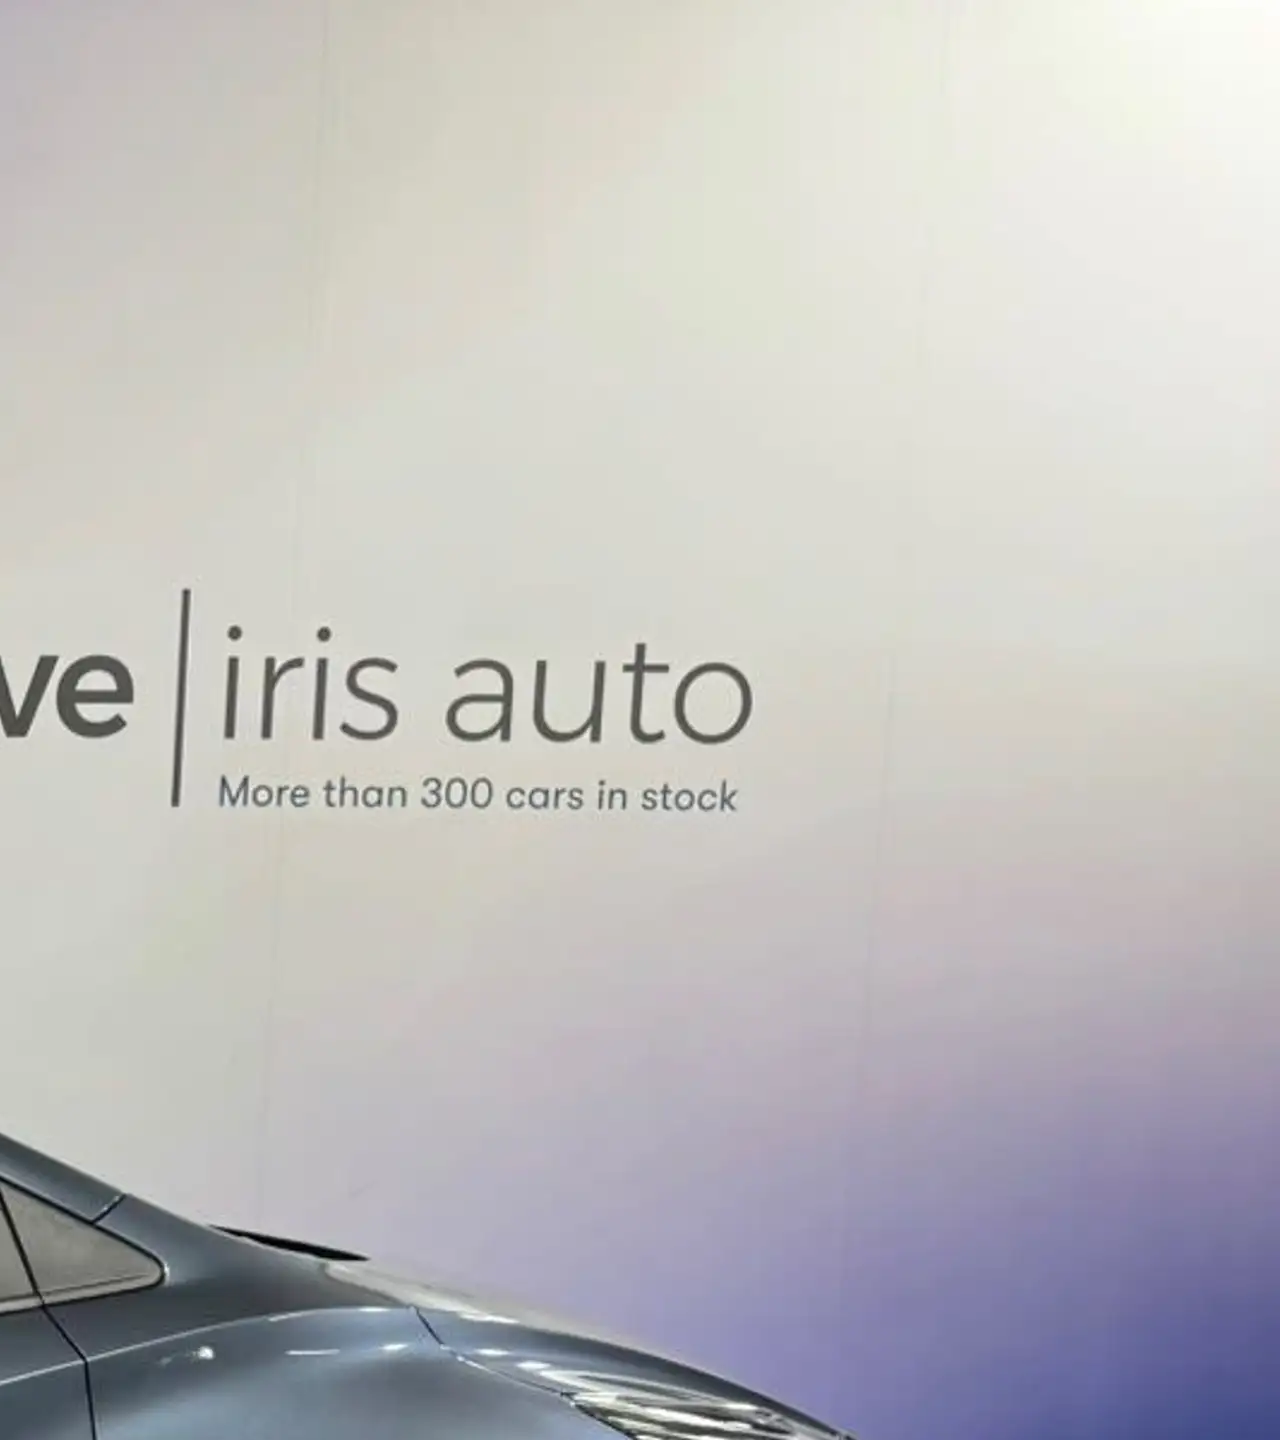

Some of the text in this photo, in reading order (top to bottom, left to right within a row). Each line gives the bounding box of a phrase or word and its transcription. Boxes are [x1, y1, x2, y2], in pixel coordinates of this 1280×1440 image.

[223, 625, 754, 746] iris auto
[217, 774, 739, 813] More than 300 cars in stock
